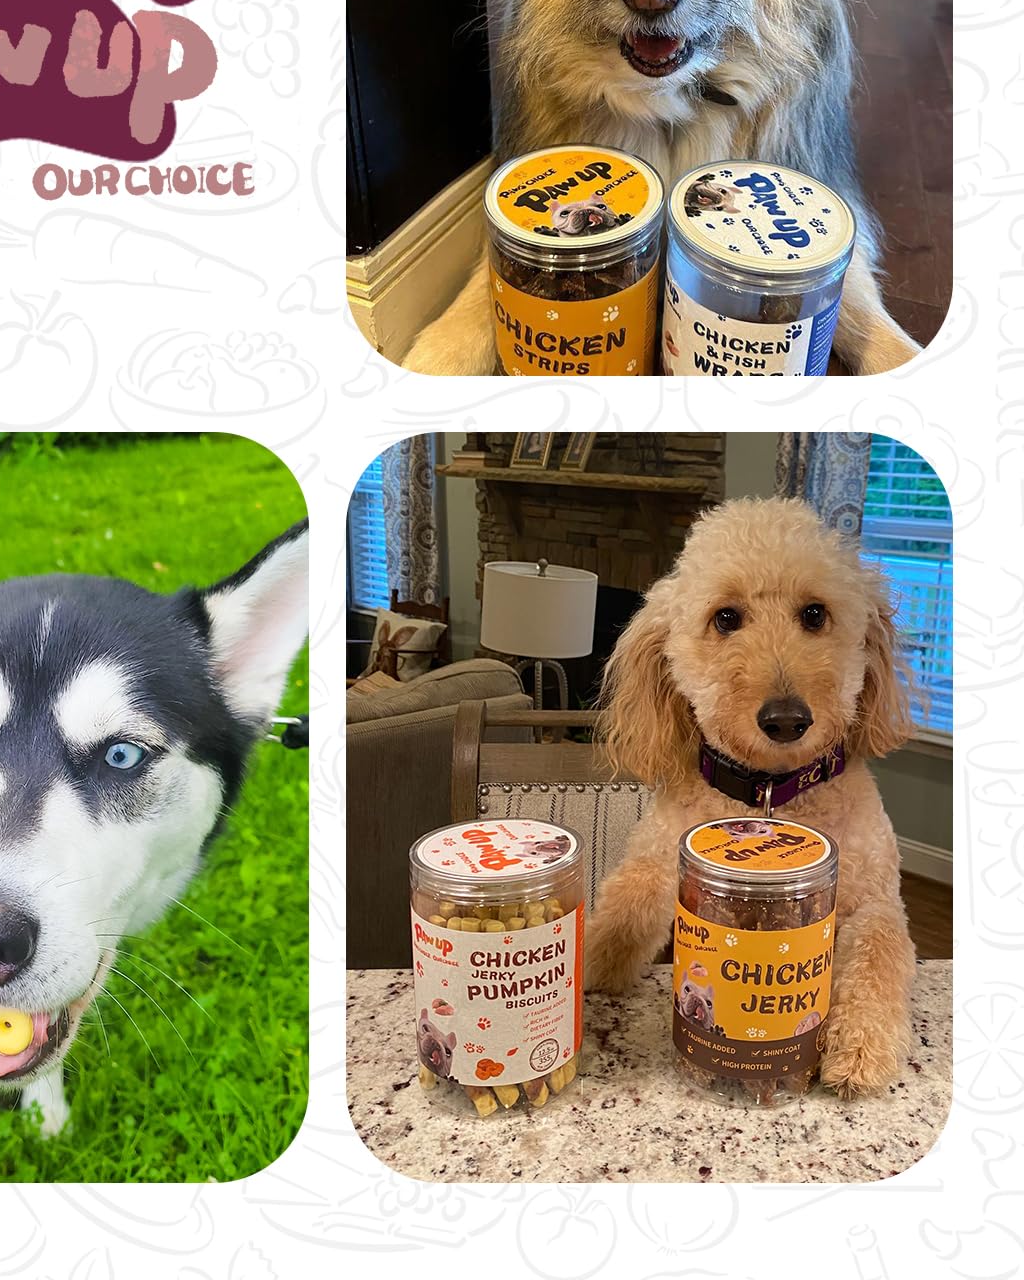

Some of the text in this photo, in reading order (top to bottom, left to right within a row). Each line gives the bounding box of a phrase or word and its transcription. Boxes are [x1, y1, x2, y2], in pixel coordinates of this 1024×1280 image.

[513, 161, 612, 213] PAW UP
[733, 172, 811, 248] PAW UP
[494, 300, 626, 356] CHICKEN
[693, 321, 791, 354] CHICKEN
[513, 343, 591, 376] STRIPS
[706, 345, 719, 359] &
[722, 351, 766, 369] FISH
[462, 829, 498, 844] UP
[724, 832, 806, 861] PAW UP
[476, 844, 523, 870] PAW
[435, 937, 453, 957] UP
[694, 925, 710, 944] UP
[470, 939, 566, 968] CHICKEN
[720, 946, 833, 986] CHICKEN
[467, 962, 565, 1001] PUMPKIN
[471, 970, 516, 981] JERKY
[505, 989, 559, 1010] BISCUITS
[741, 987, 820, 1014] JERKY
[687, 1031, 736, 1055] TAURINE ADDED
[763, 1044, 801, 1057] SHINY COAT
[722, 1060, 772, 1070] HIGH PROTEIN
